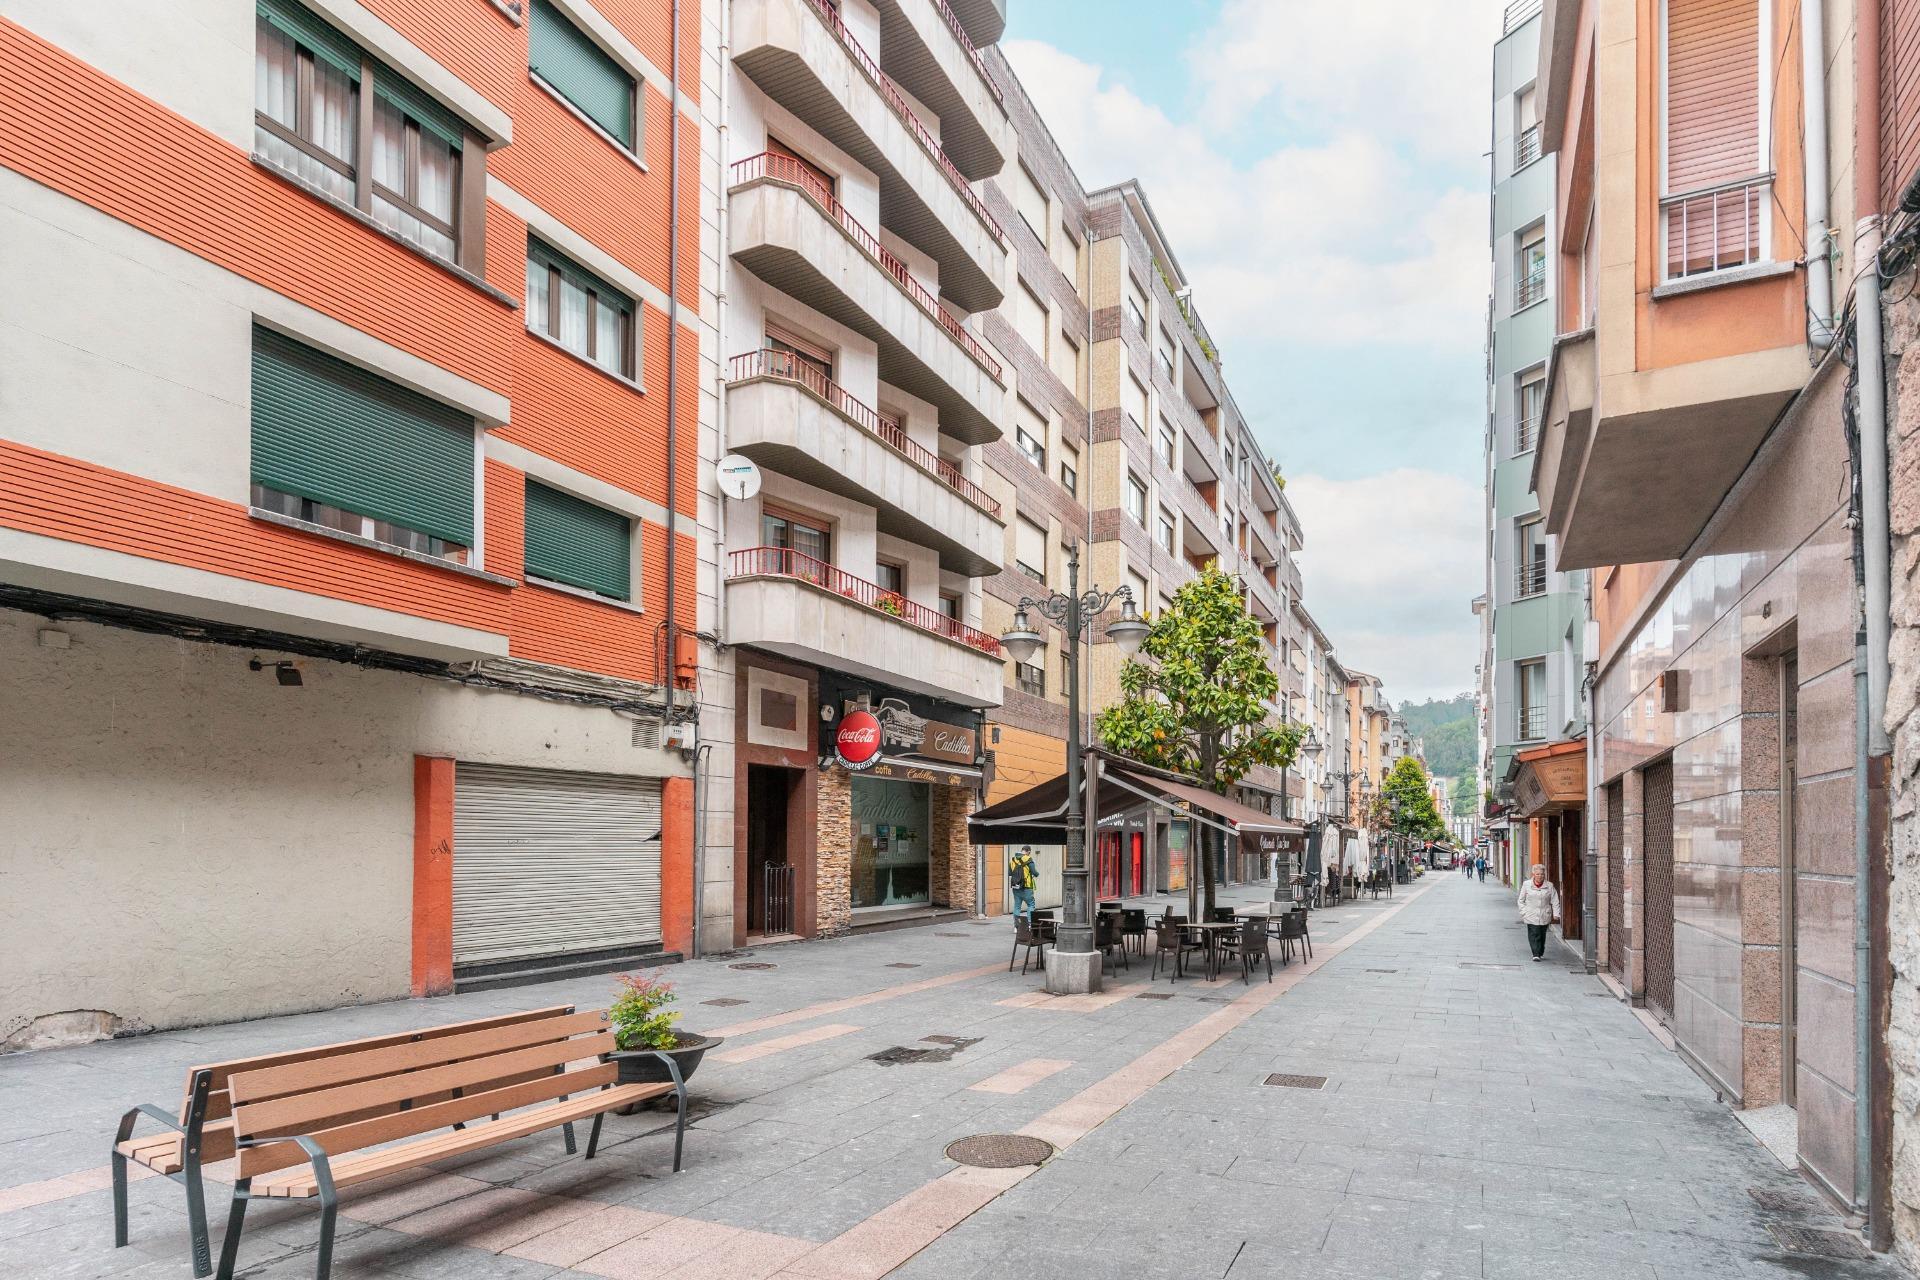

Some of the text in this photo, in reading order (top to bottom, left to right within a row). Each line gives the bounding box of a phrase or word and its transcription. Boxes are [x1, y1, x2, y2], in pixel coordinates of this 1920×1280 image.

[838, 728, 877, 744] Coca-Cola
[934, 731, 970, 755] Cadillac
[875, 765, 892, 776] coffe
[906, 767, 937, 783] Cadillac
